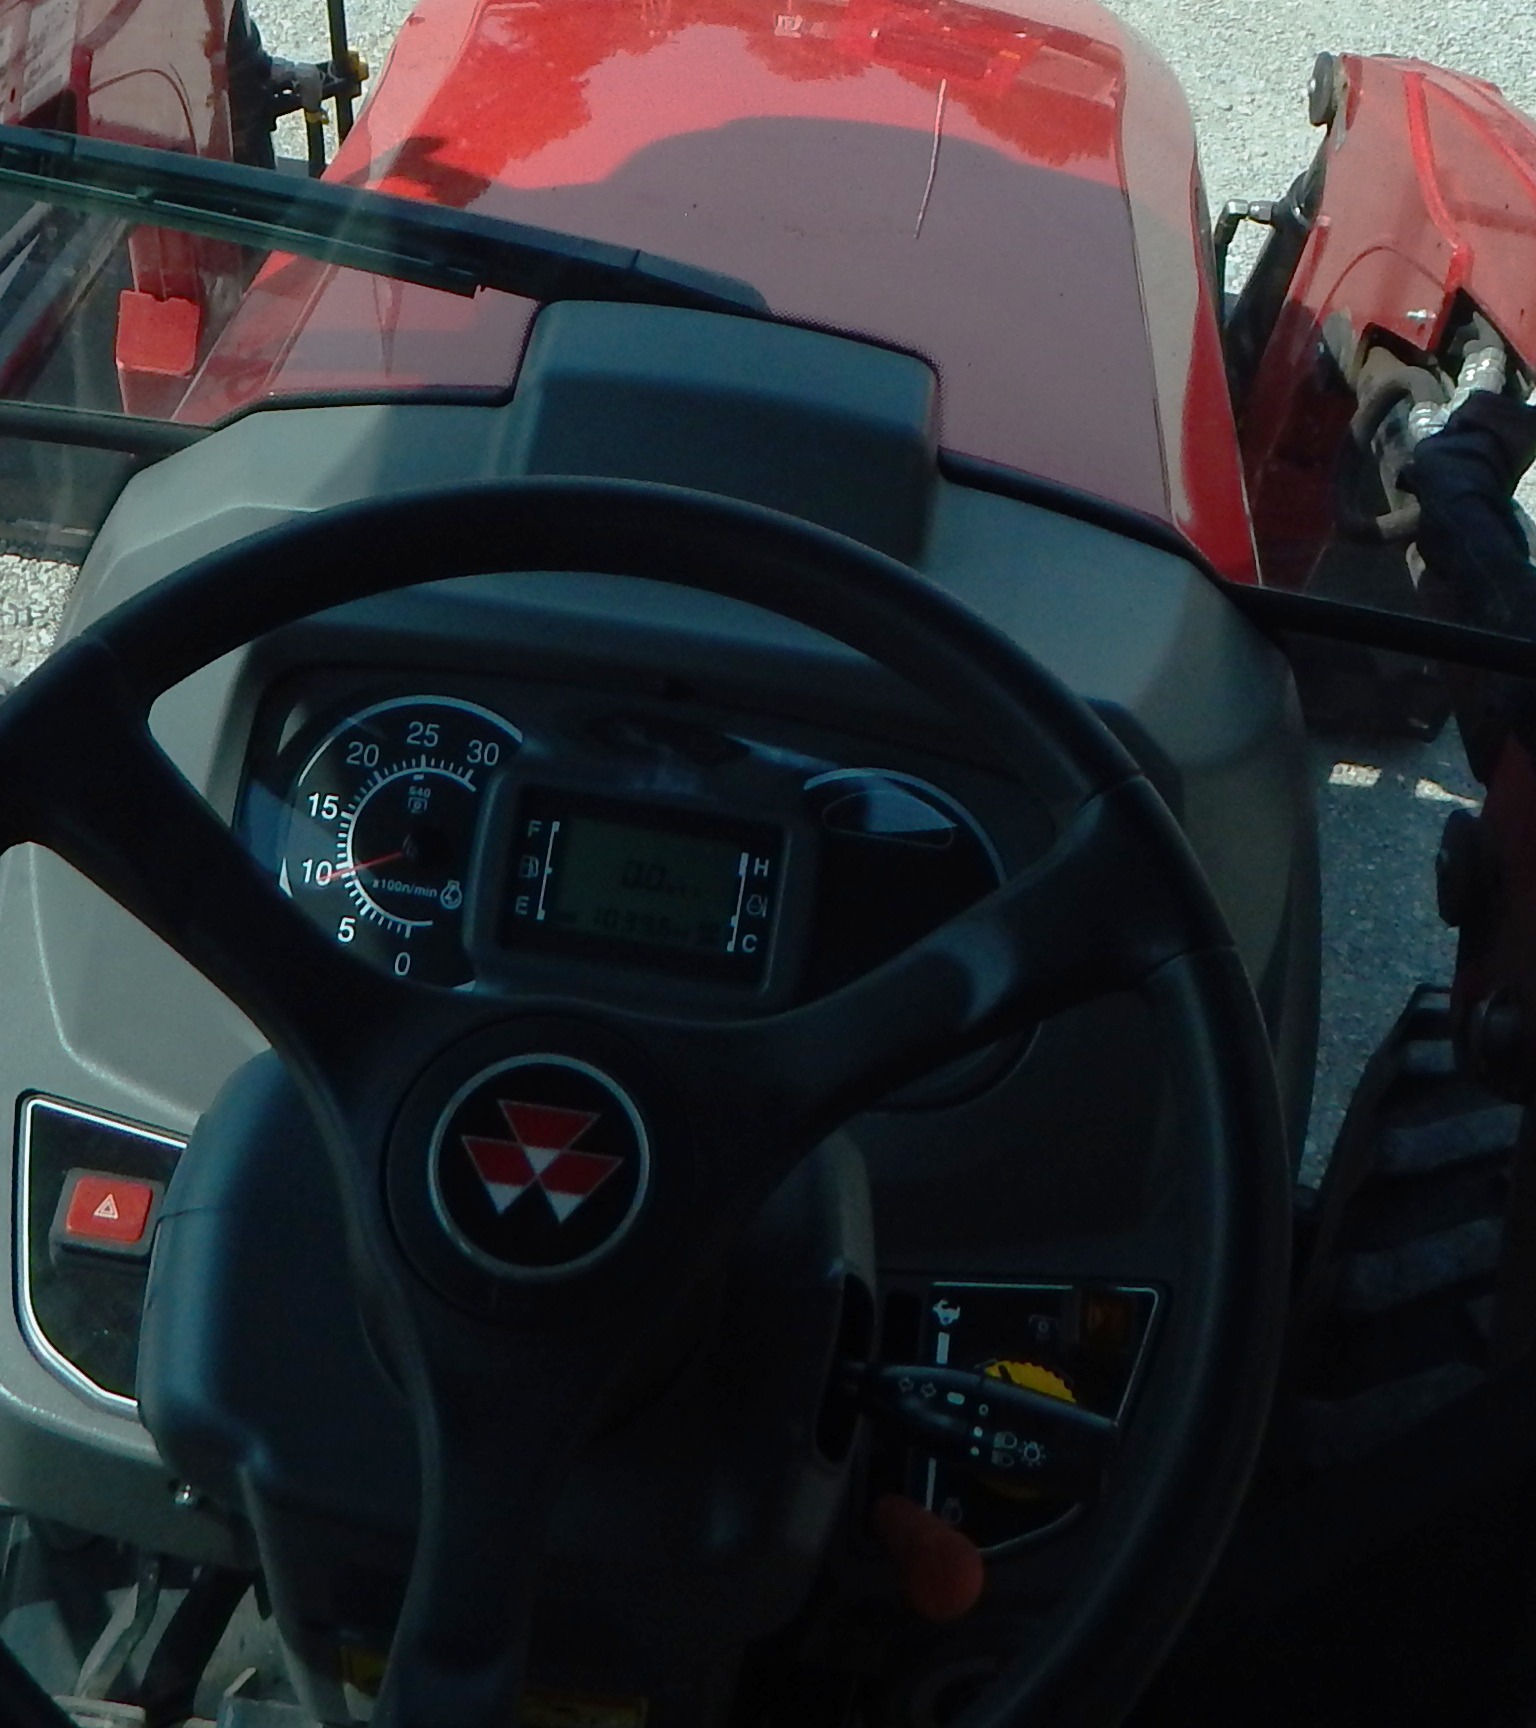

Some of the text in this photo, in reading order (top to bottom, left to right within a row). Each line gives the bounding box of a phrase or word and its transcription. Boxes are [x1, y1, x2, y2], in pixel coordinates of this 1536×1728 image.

[405, 720, 441, 748] 25
[345, 740, 380, 767] 20
[466, 738, 500, 766] 30
[308, 791, 341, 821] 15
[527, 819, 543, 839] F
[302, 858, 333, 887] 10
[753, 856, 770, 878] H
[514, 895, 531, 916] E
[337, 915, 357, 943] 5
[741, 933, 759, 953] C
[394, 951, 412, 977] 0
